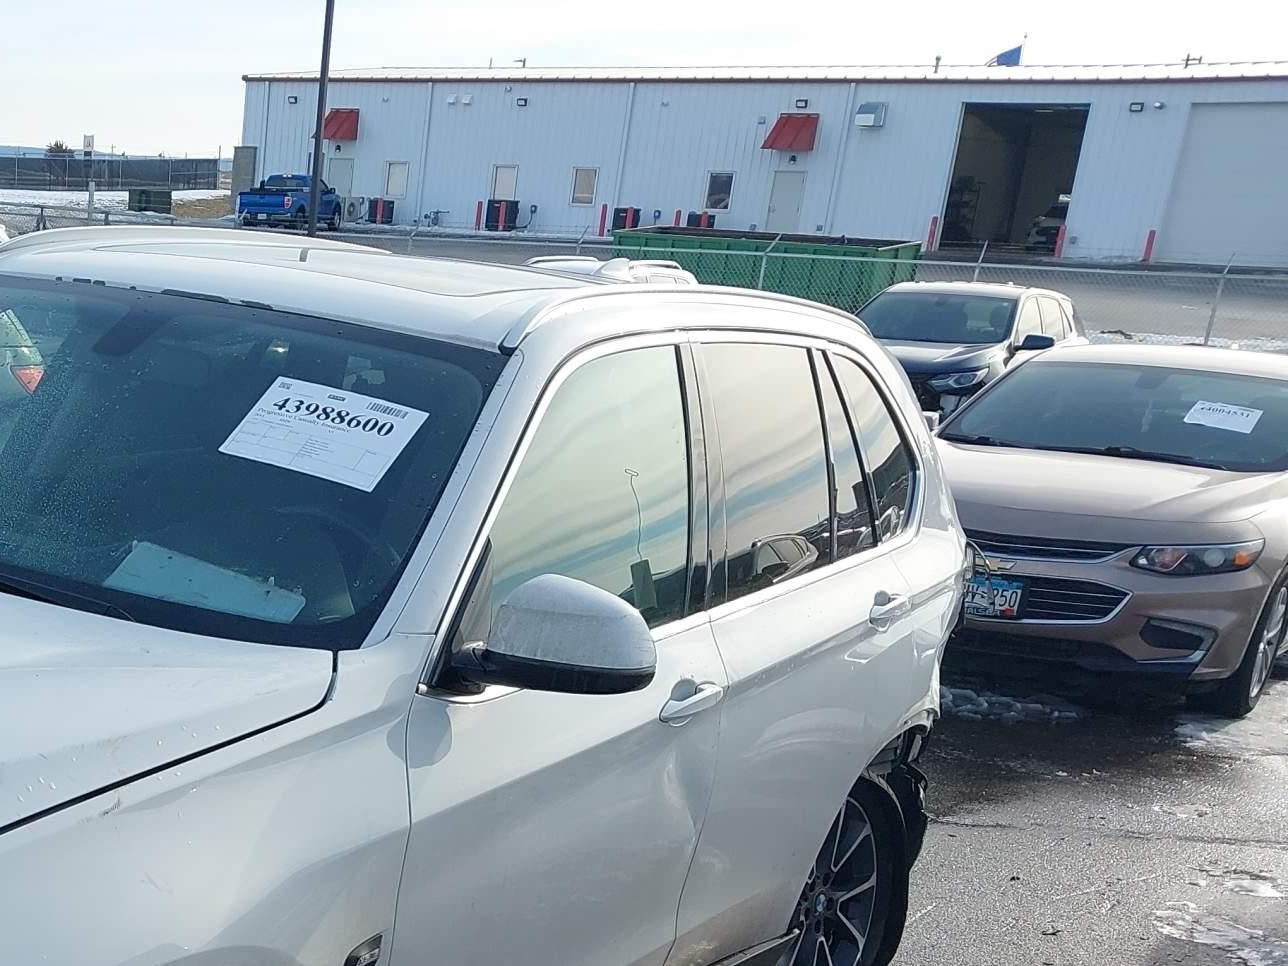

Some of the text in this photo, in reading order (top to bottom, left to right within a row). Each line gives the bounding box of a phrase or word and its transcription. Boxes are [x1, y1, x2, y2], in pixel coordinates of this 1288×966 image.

[257, 407, 293, 419] Progressive
[321, 422, 351, 433] Insurance
[273, 397, 395, 437] 43988600
